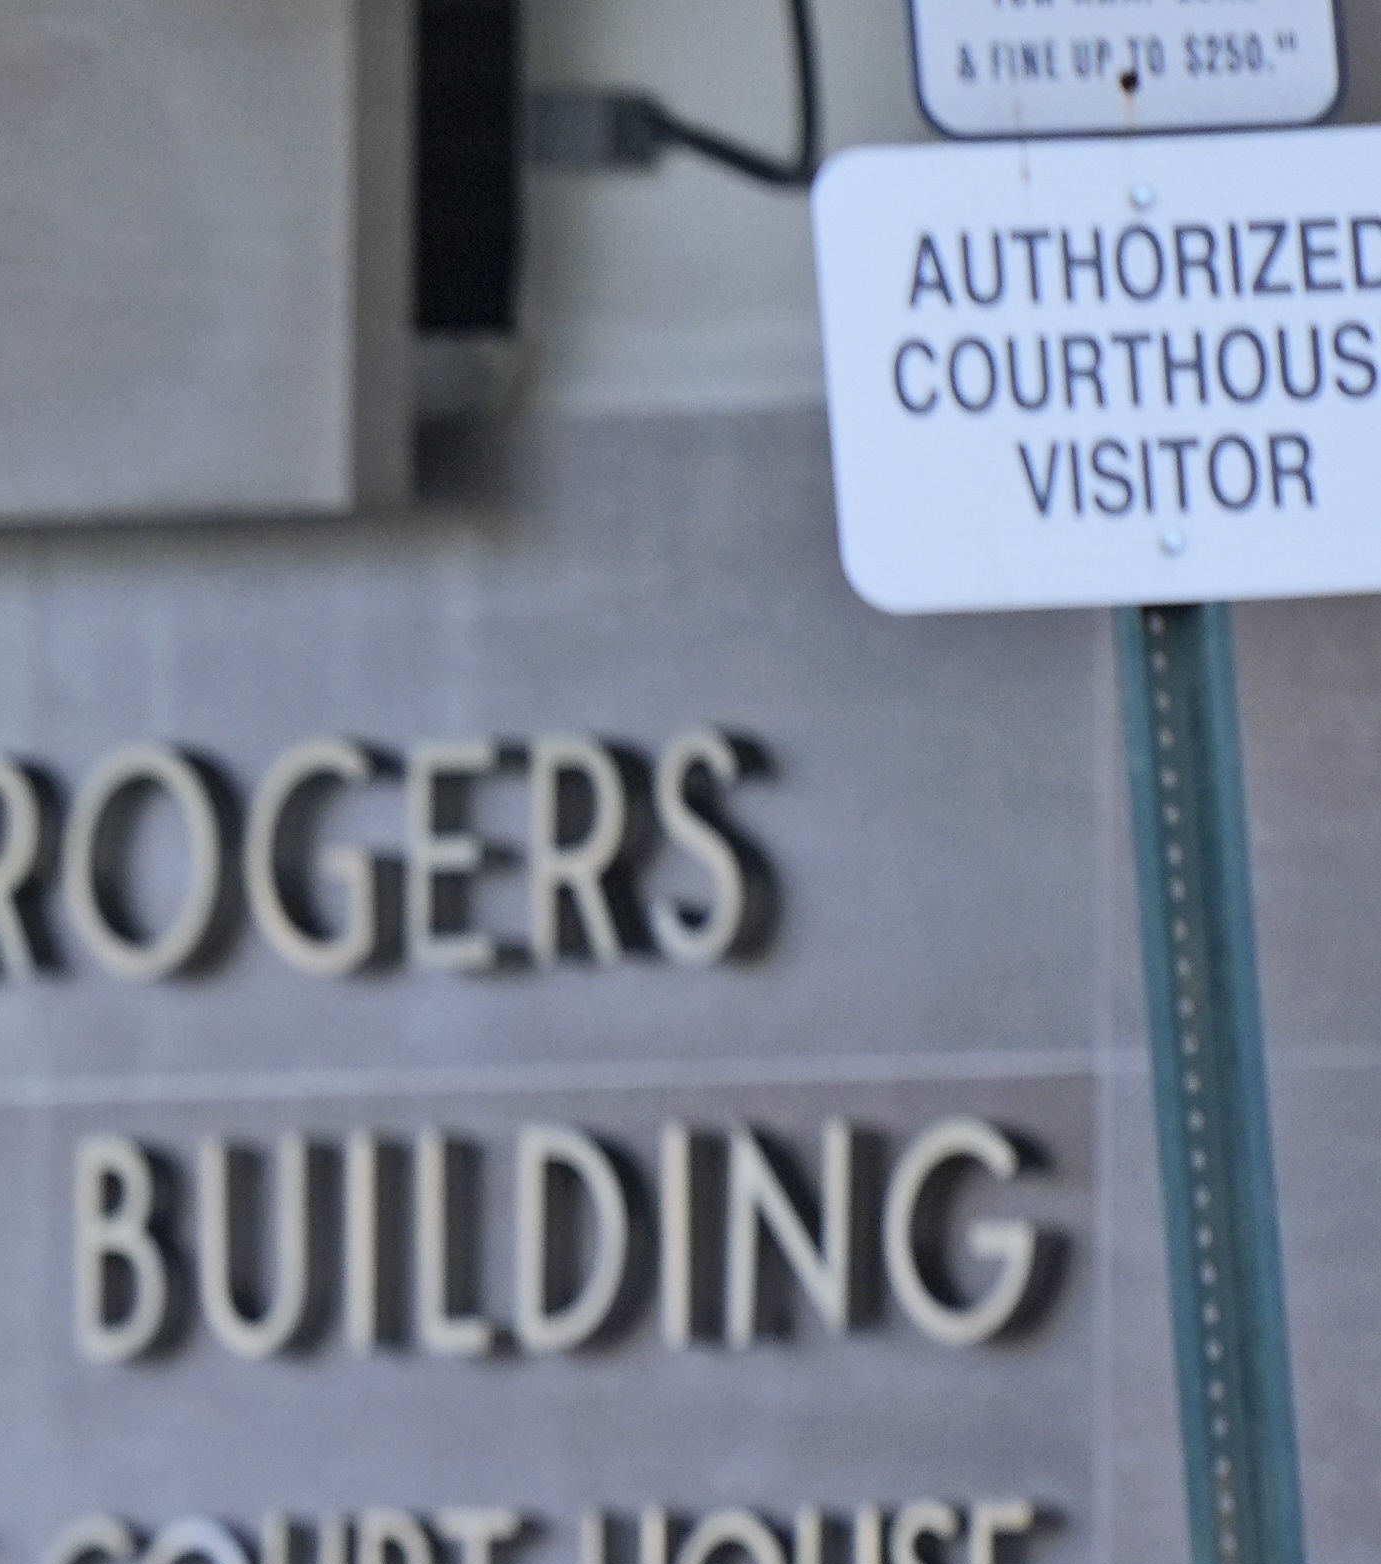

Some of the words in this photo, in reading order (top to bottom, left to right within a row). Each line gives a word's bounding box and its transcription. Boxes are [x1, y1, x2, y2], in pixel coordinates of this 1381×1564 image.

[991, 37, 1059, 79] FINE
[1072, 36, 1112, 78] UP
[1126, 34, 1166, 76] TO
[908, 217, 1381, 307] AUTHORIZED
[892, 321, 1380, 414] COURTHOUS
[1016, 432, 1316, 517] VISITOR
[73, 1114, 1038, 1364] BUILDING
